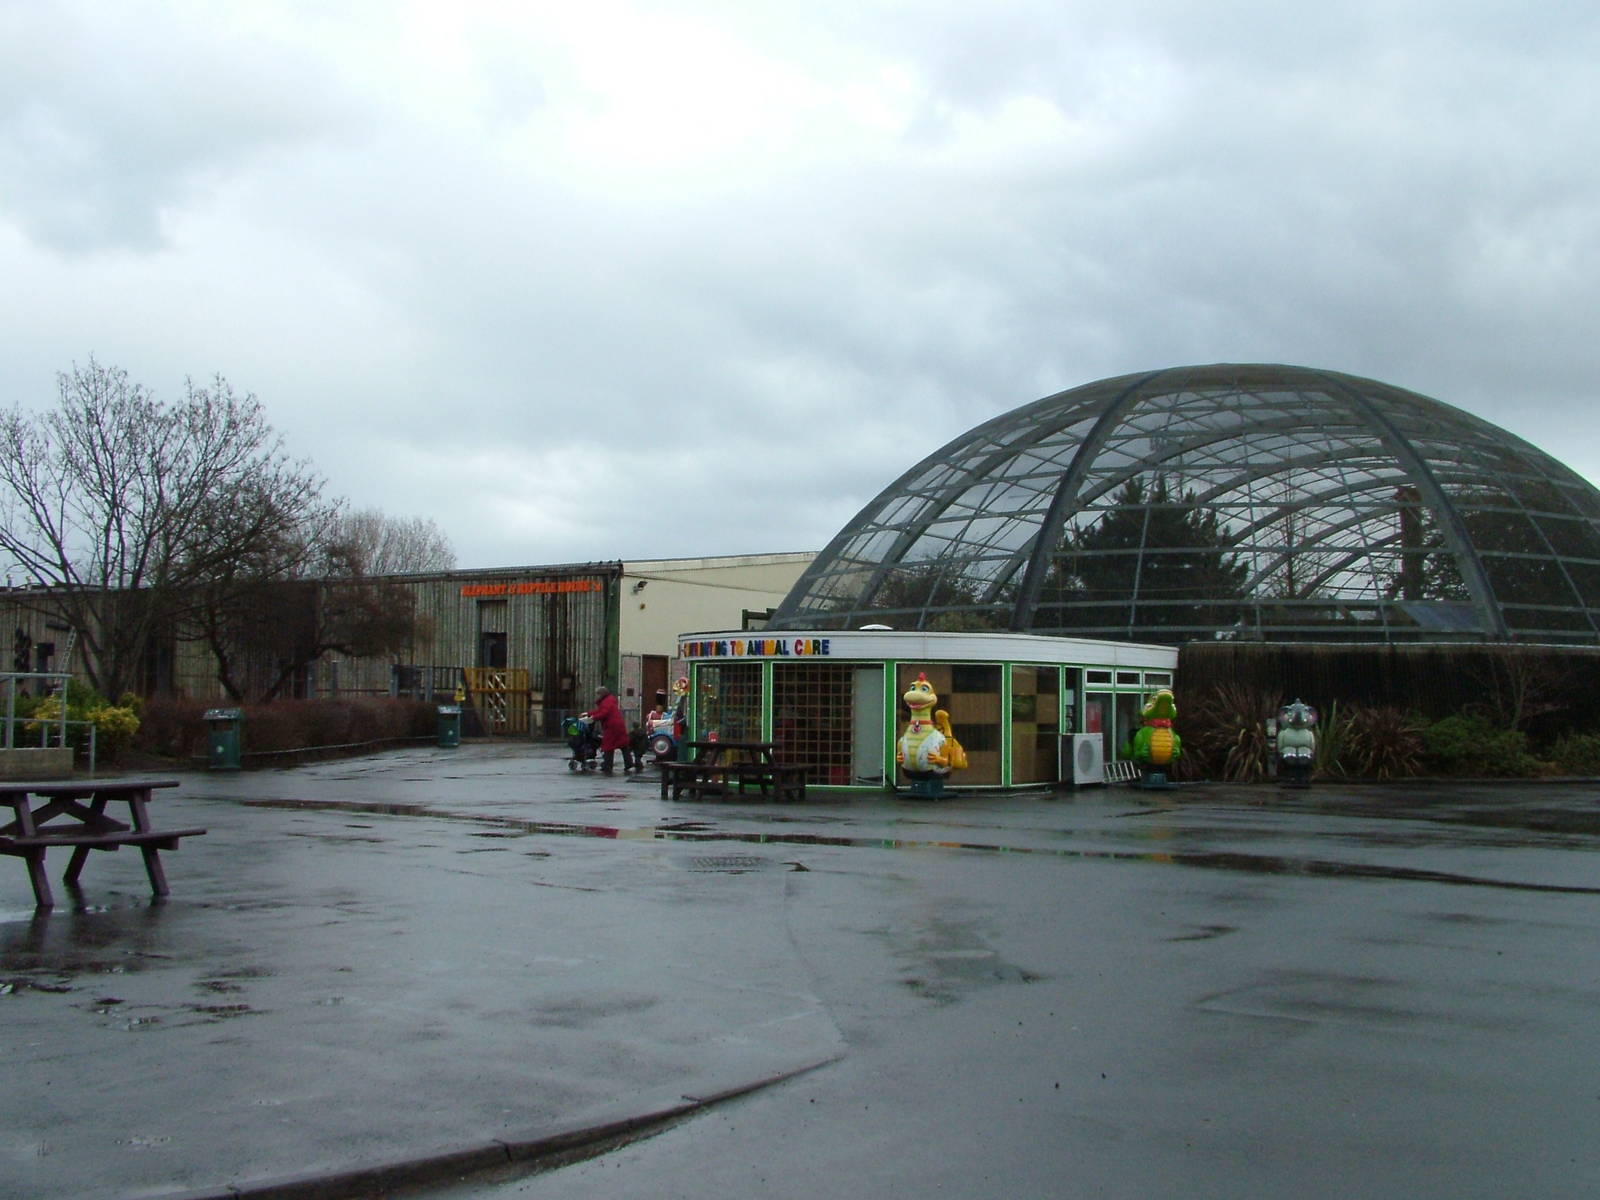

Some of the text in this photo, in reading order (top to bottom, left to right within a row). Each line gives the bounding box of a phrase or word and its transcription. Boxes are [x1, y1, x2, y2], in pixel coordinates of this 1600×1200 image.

[730, 640, 744, 656] TO
[747, 640, 789, 656] ANIMAL
[795, 639, 830, 655] CARE
